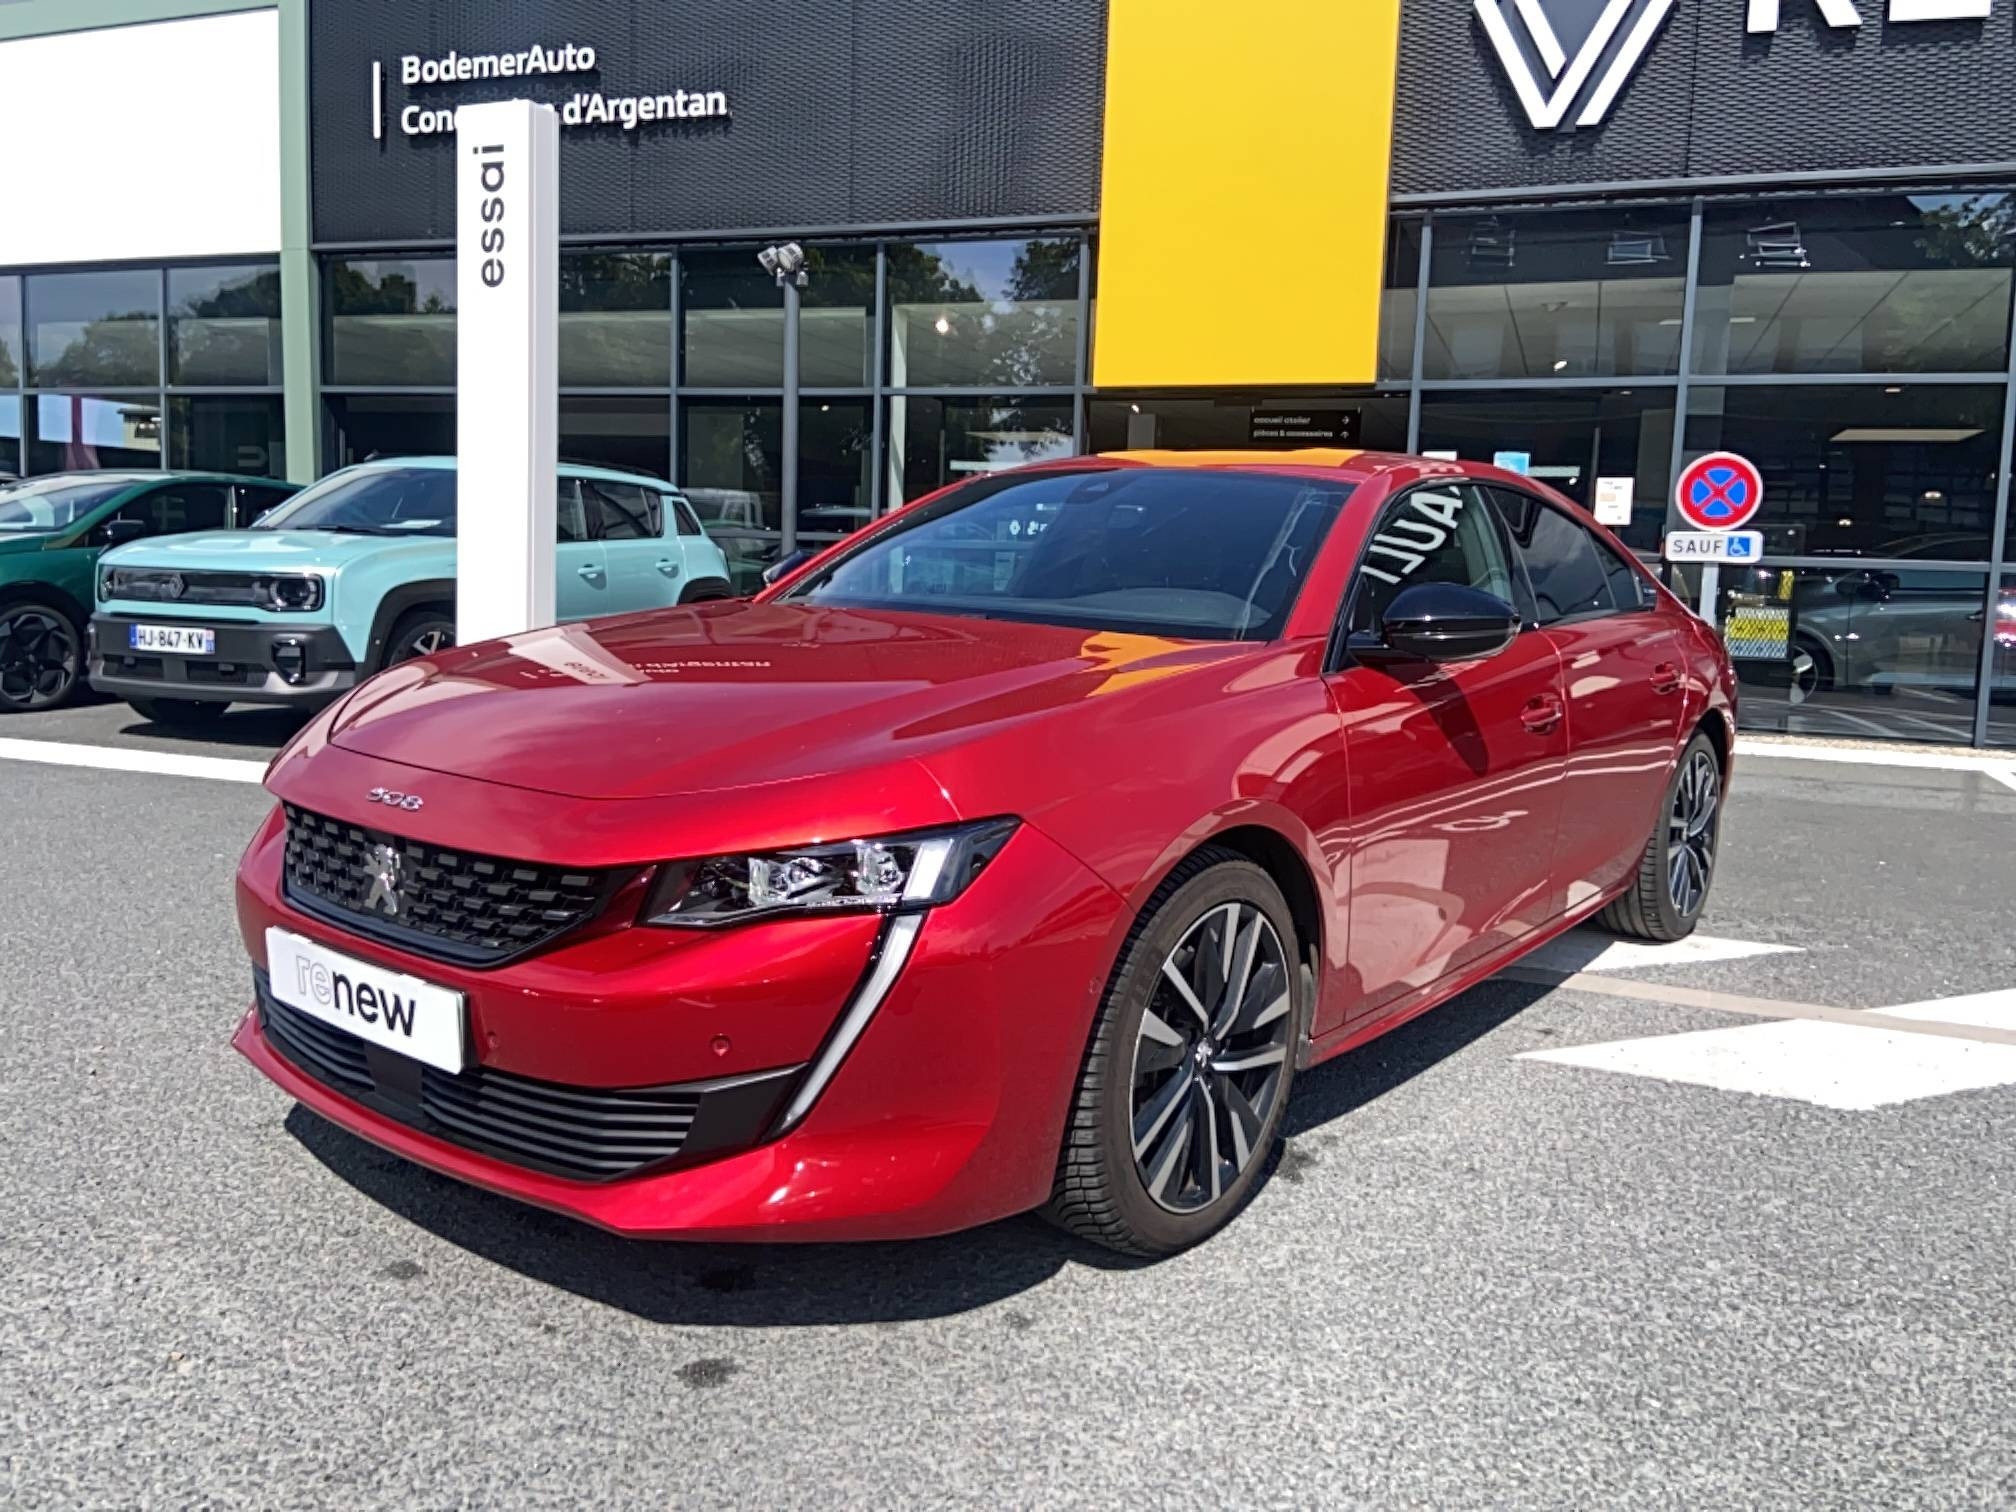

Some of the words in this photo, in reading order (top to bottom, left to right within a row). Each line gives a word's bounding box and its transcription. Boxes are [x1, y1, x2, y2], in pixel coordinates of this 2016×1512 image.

[401, 43, 596, 85] BodemerAuto
[563, 90, 727, 130] d'Argentan
[473, 144, 504, 288] essai
[1672, 538, 1724, 554] SAUF
[138, 630, 203, 648] HJ-847-KV
[365, 787, 423, 811] 508
[295, 955, 416, 1037] renew
